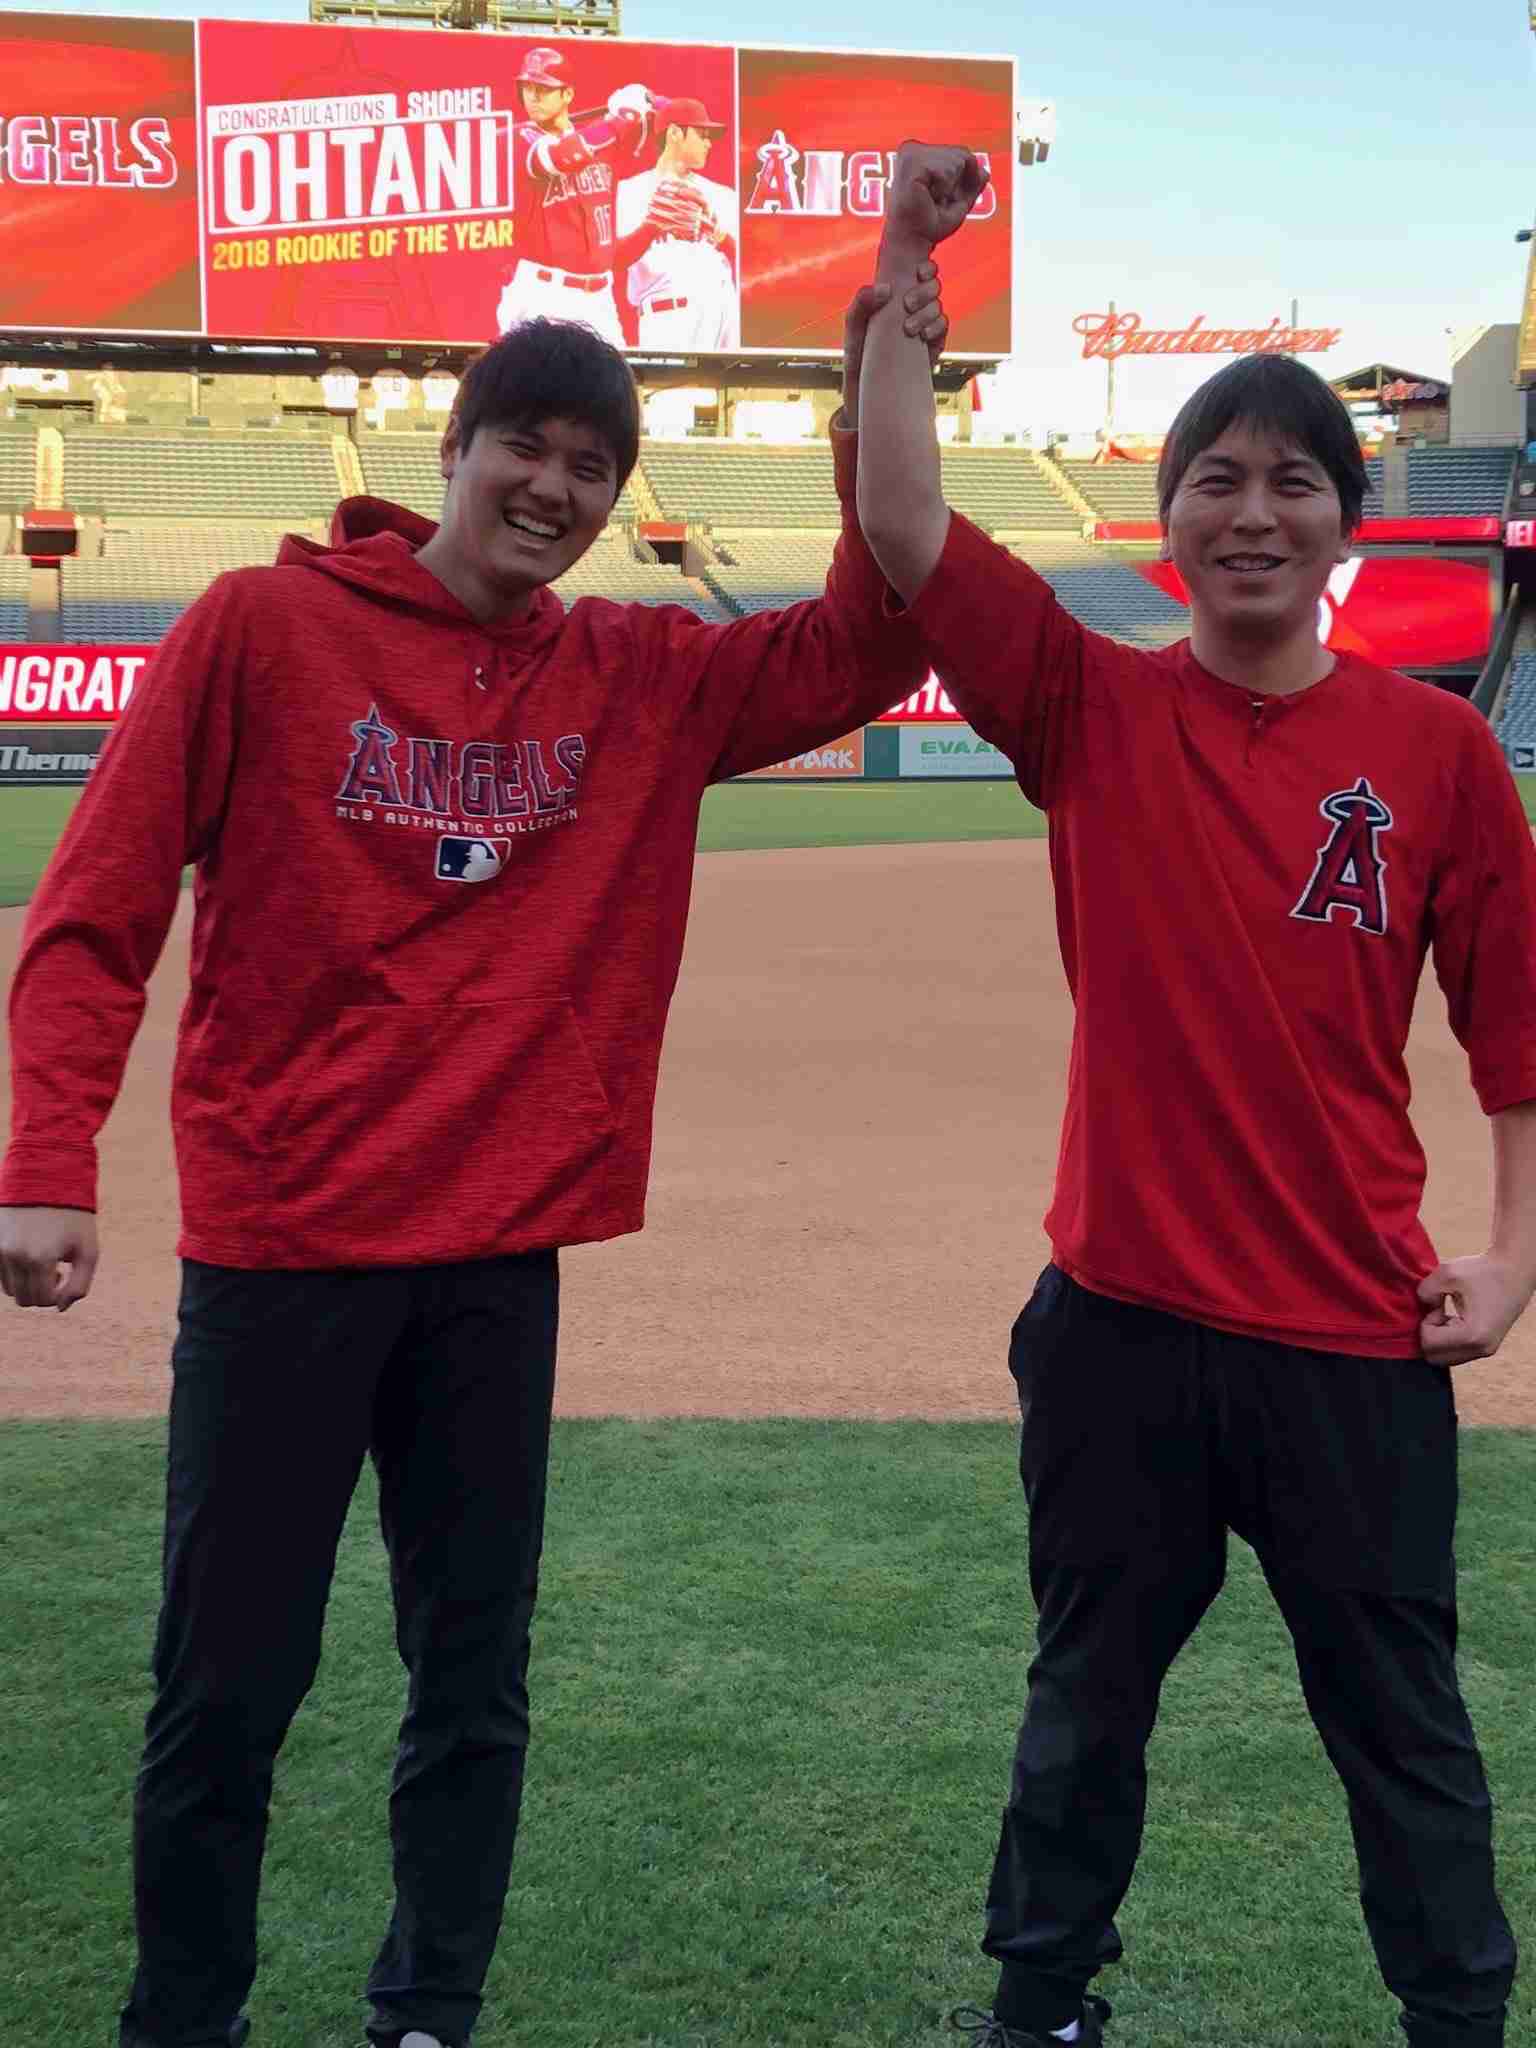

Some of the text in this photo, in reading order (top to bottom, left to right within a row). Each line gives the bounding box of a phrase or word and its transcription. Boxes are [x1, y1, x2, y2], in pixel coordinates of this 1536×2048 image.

[218, 85, 492, 131] CONGRATULATIONS SHOHEI
[0, 115, 178, 188] GELS
[223, 119, 498, 226] OHTANI
[212, 218, 514, 271] 2018 ROOKIE OF THE YEAR
[1072, 312, 1343, 359] Budweiser
[334, 702, 586, 818] ANGELS
[920, 740, 999, 755] EVA A
[335, 806, 374, 822] MLB
[493, 807, 578, 834] COLLECTN
[1289, 777, 1393, 935] A
